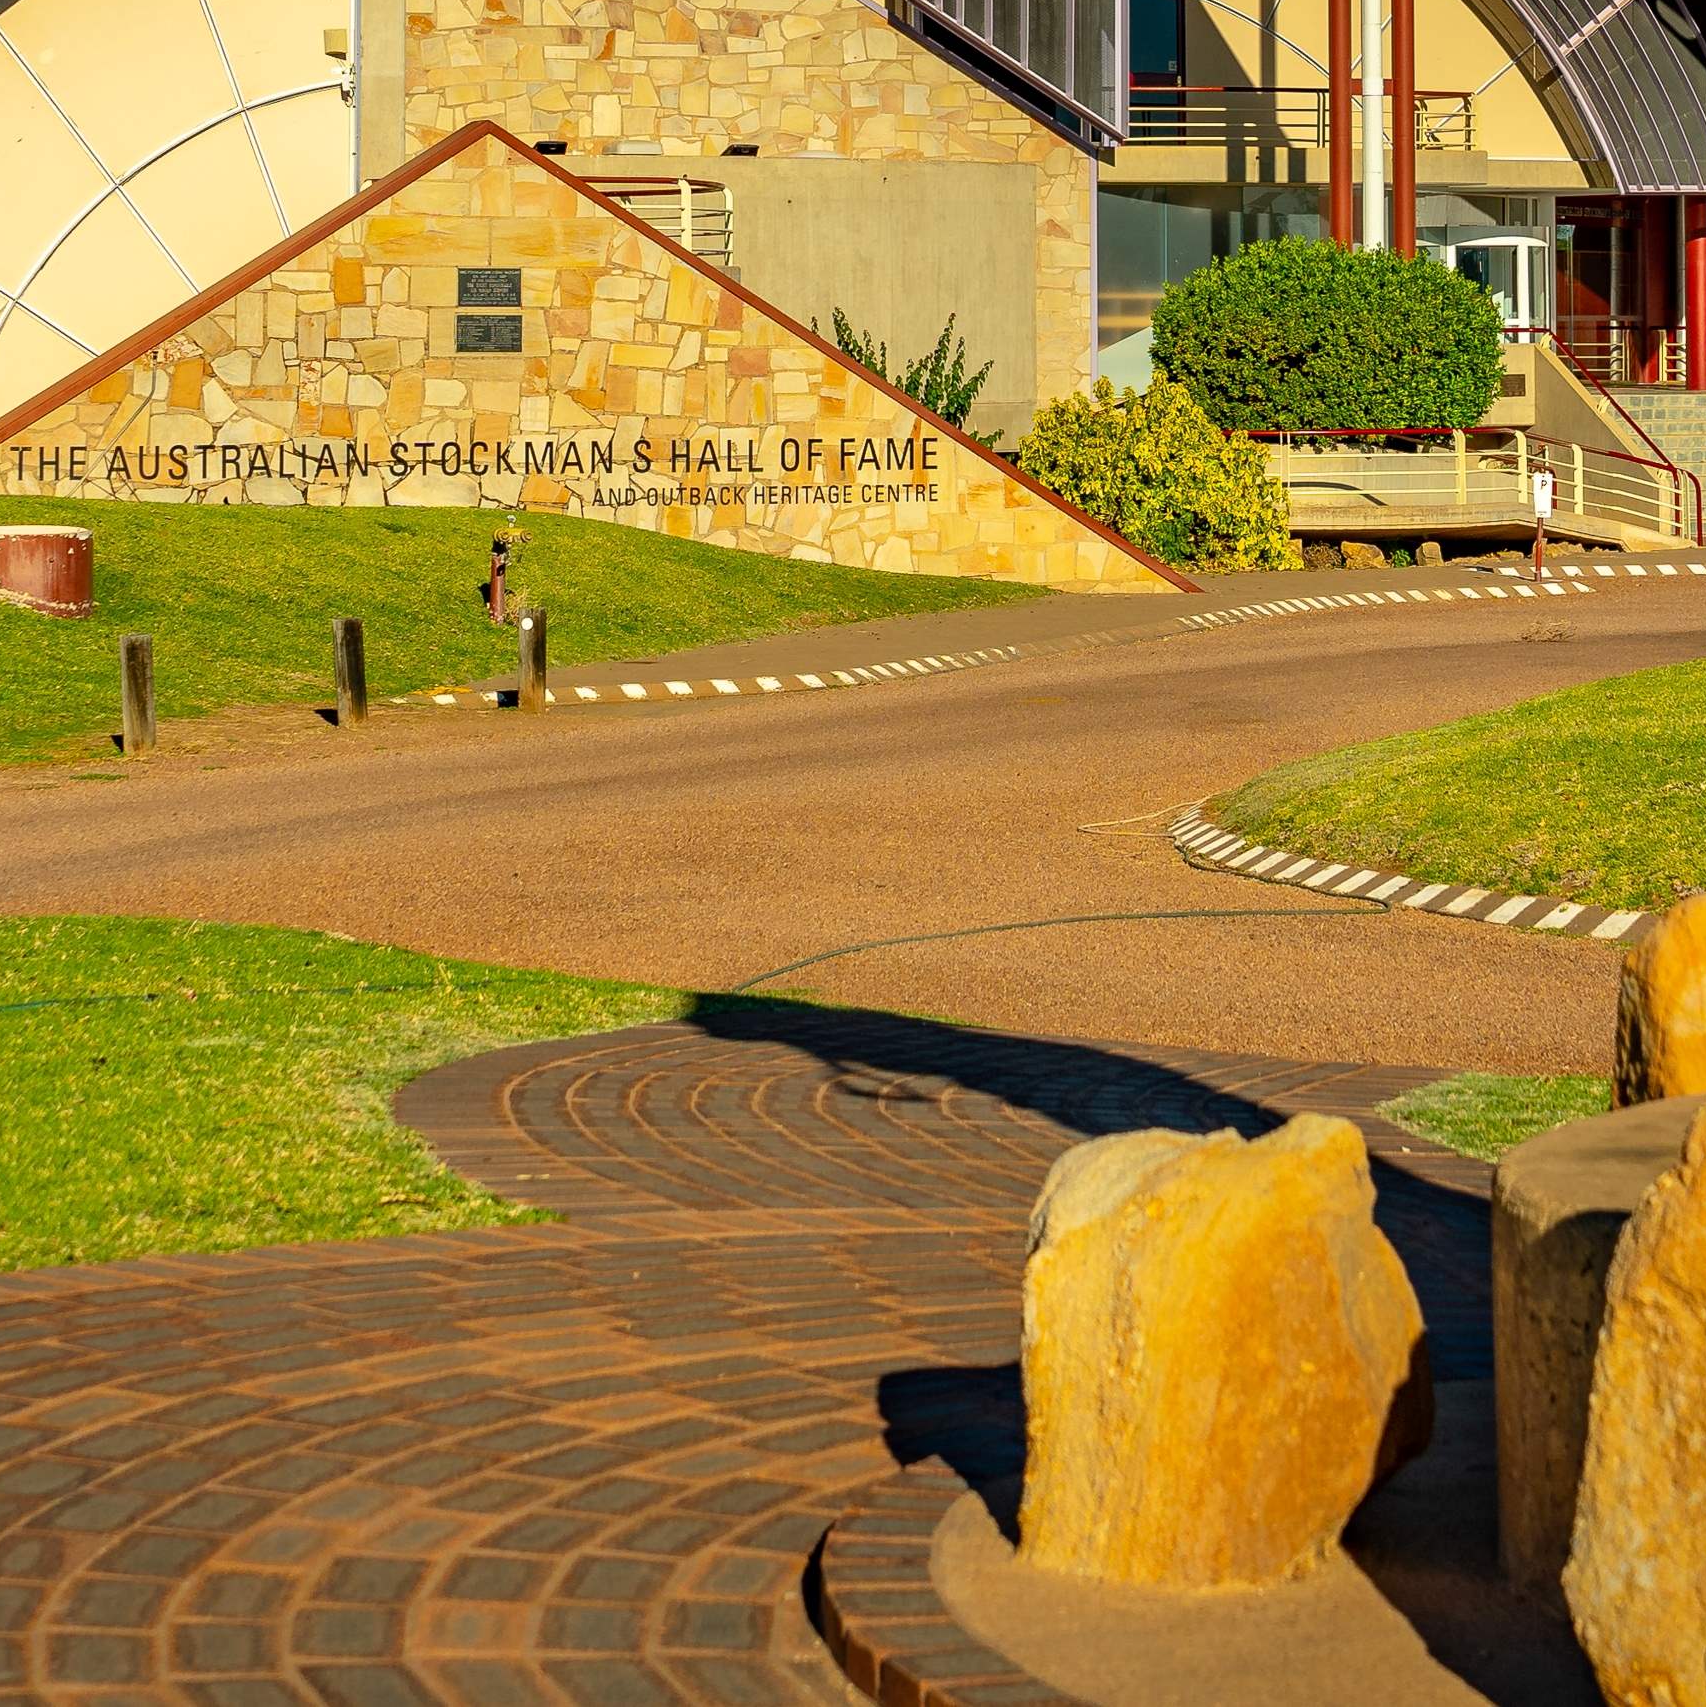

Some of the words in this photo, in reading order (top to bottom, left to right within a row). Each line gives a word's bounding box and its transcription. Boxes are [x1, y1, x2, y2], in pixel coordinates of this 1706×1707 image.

[10, 445, 87, 482] THE
[107, 442, 371, 482] AUSTRALIAN
[671, 438, 764, 474] HALL
[780, 437, 824, 473] OF
[840, 437, 939, 473] FAME
[592, 487, 639, 508] AND
[646, 487, 745, 508] OUTBACK
[754, 485, 854, 507] HERITAGE
[861, 483, 940, 505] CENTRE
